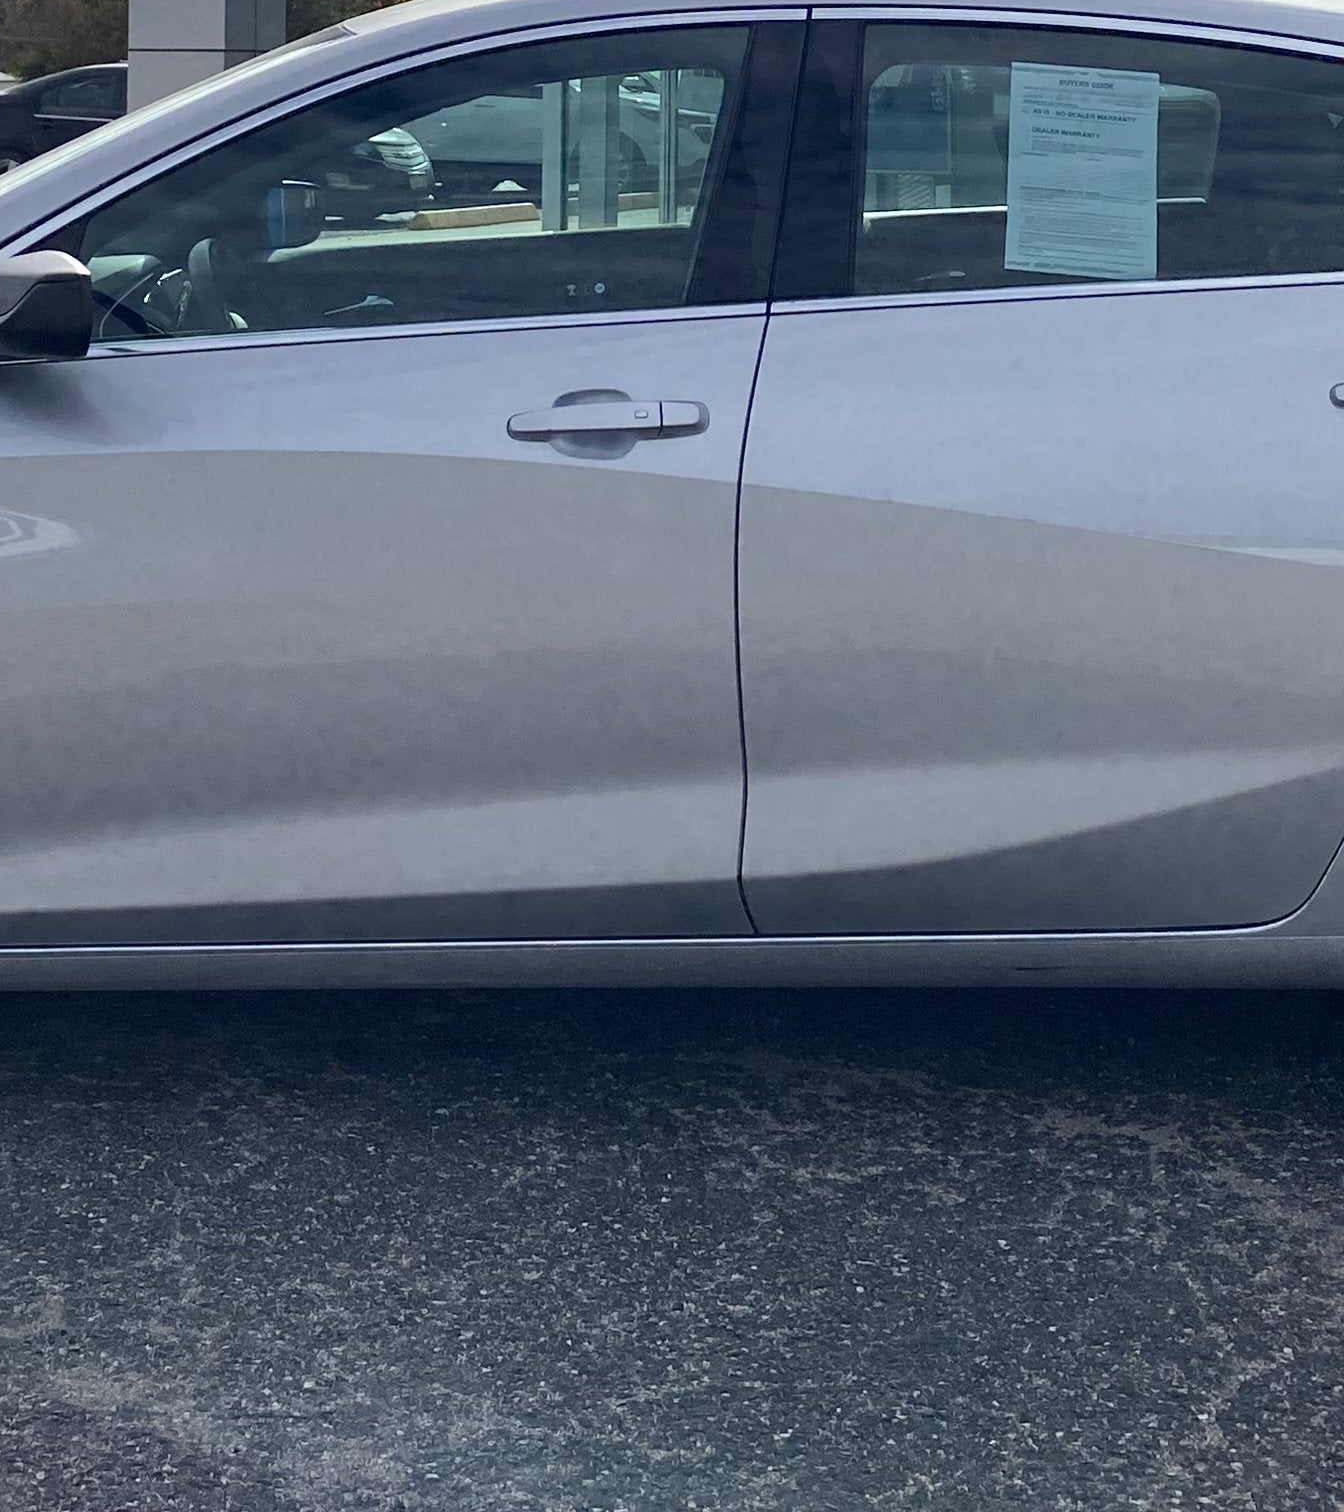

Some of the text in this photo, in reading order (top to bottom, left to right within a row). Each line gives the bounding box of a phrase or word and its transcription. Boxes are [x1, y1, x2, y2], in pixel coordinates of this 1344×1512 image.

[1068, 112, 1095, 120] DEALER
[1097, 115, 1136, 123] WARRANTY
[1032, 126, 1100, 139] DEALER WARRANTY
